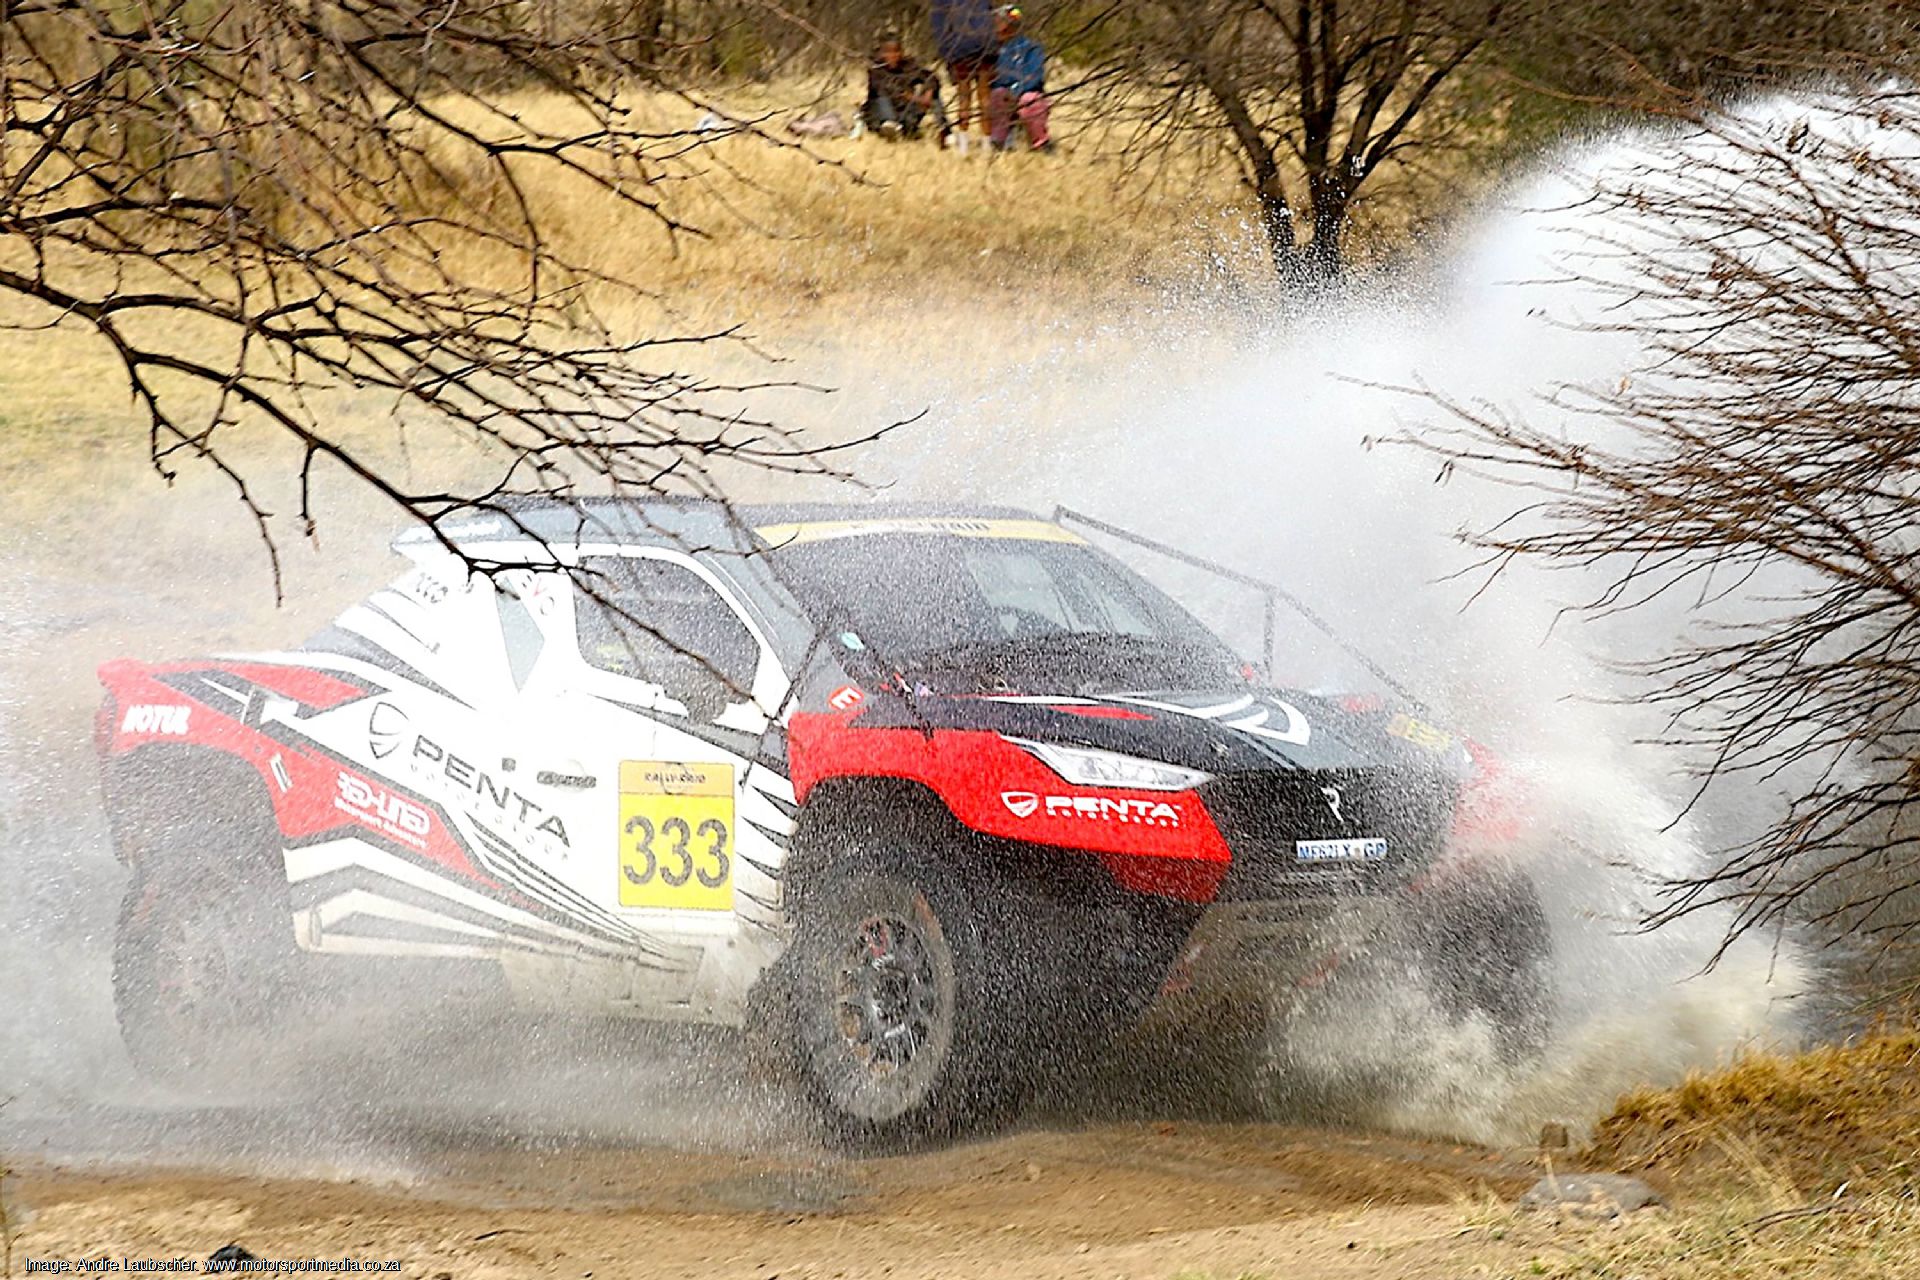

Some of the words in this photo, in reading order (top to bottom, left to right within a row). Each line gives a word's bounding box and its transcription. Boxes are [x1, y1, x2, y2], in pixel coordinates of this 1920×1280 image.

[412, 734, 570, 848] PENTA
[1045, 796, 1179, 821] PENTA
[623, 815, 730, 889] 333
